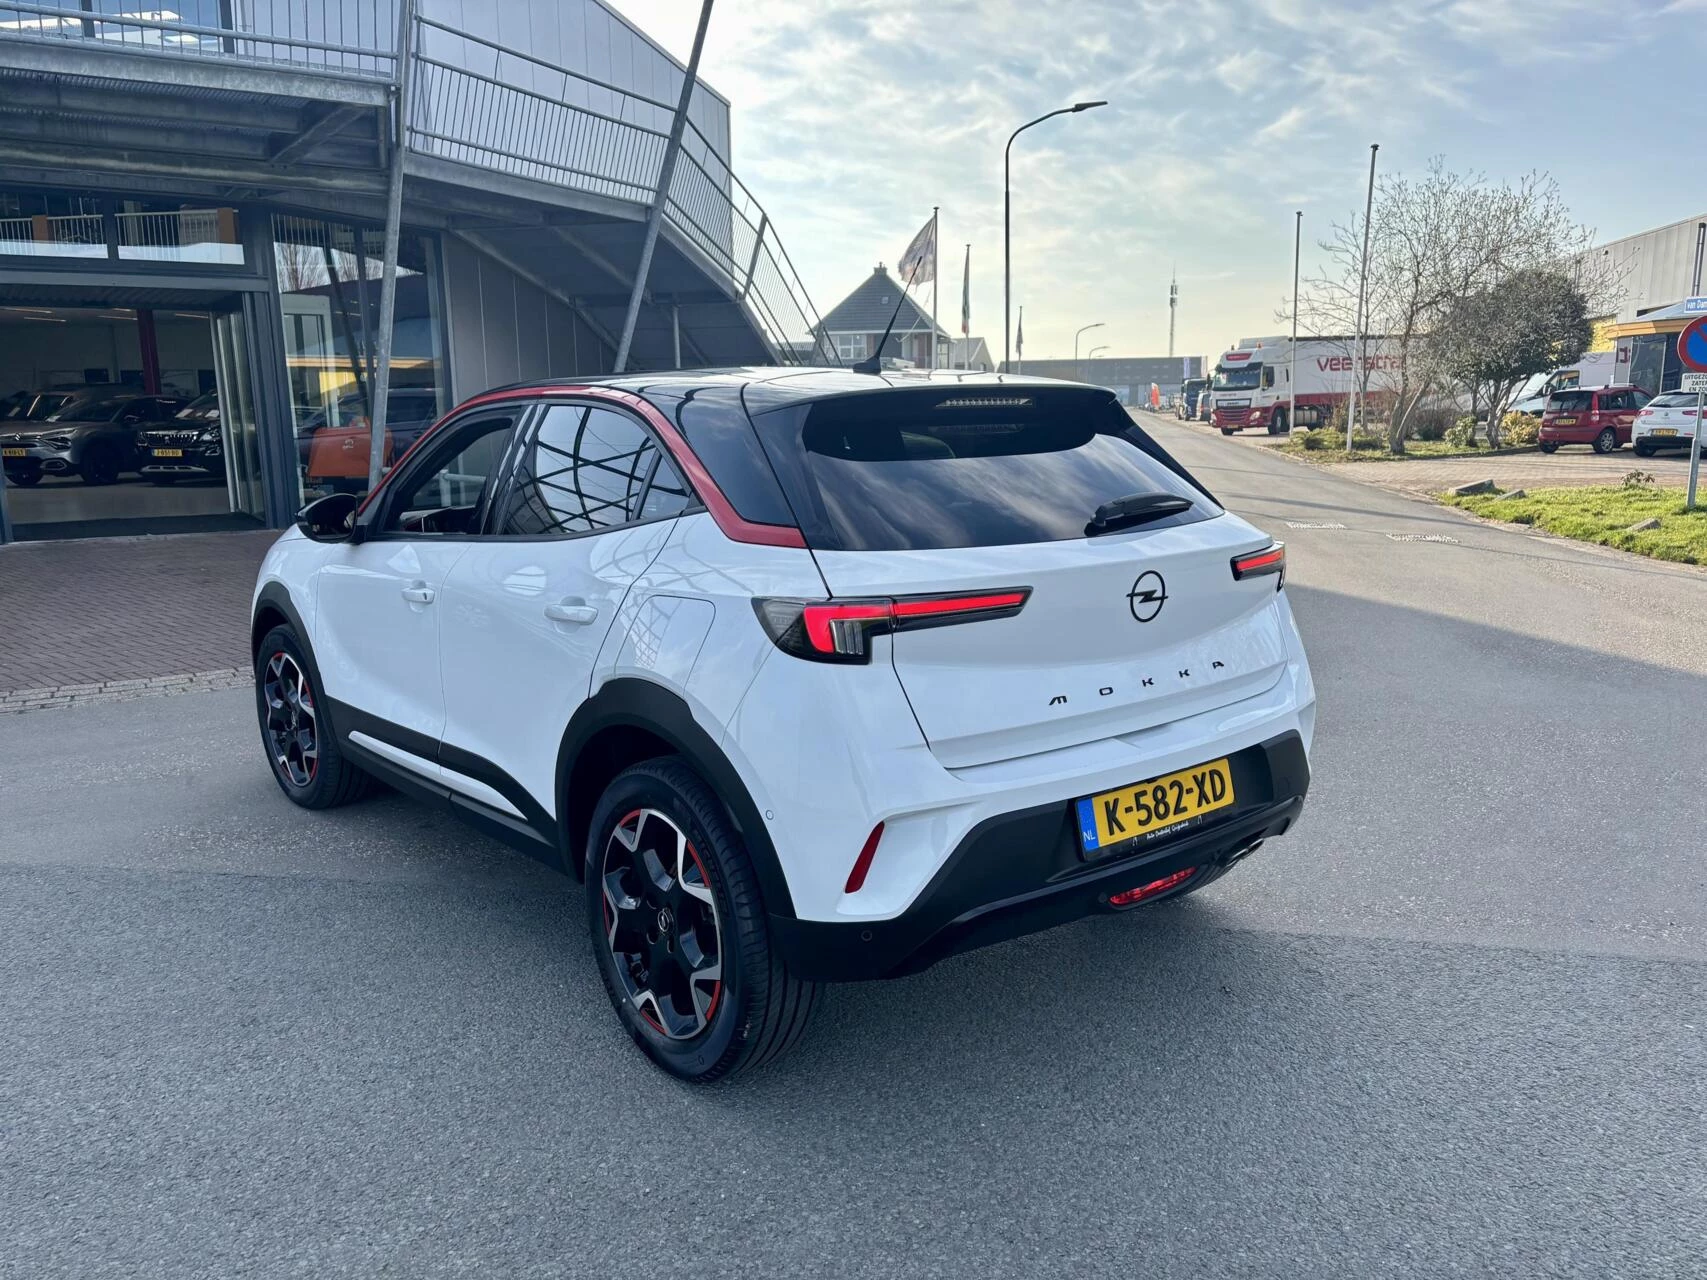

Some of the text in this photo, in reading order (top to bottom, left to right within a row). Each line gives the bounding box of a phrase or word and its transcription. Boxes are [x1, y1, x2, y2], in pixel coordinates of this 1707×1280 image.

[1049, 661, 1224, 706] MOKKA
[1104, 768, 1226, 836] K-582-XD
[1083, 831, 1096, 842] NL
